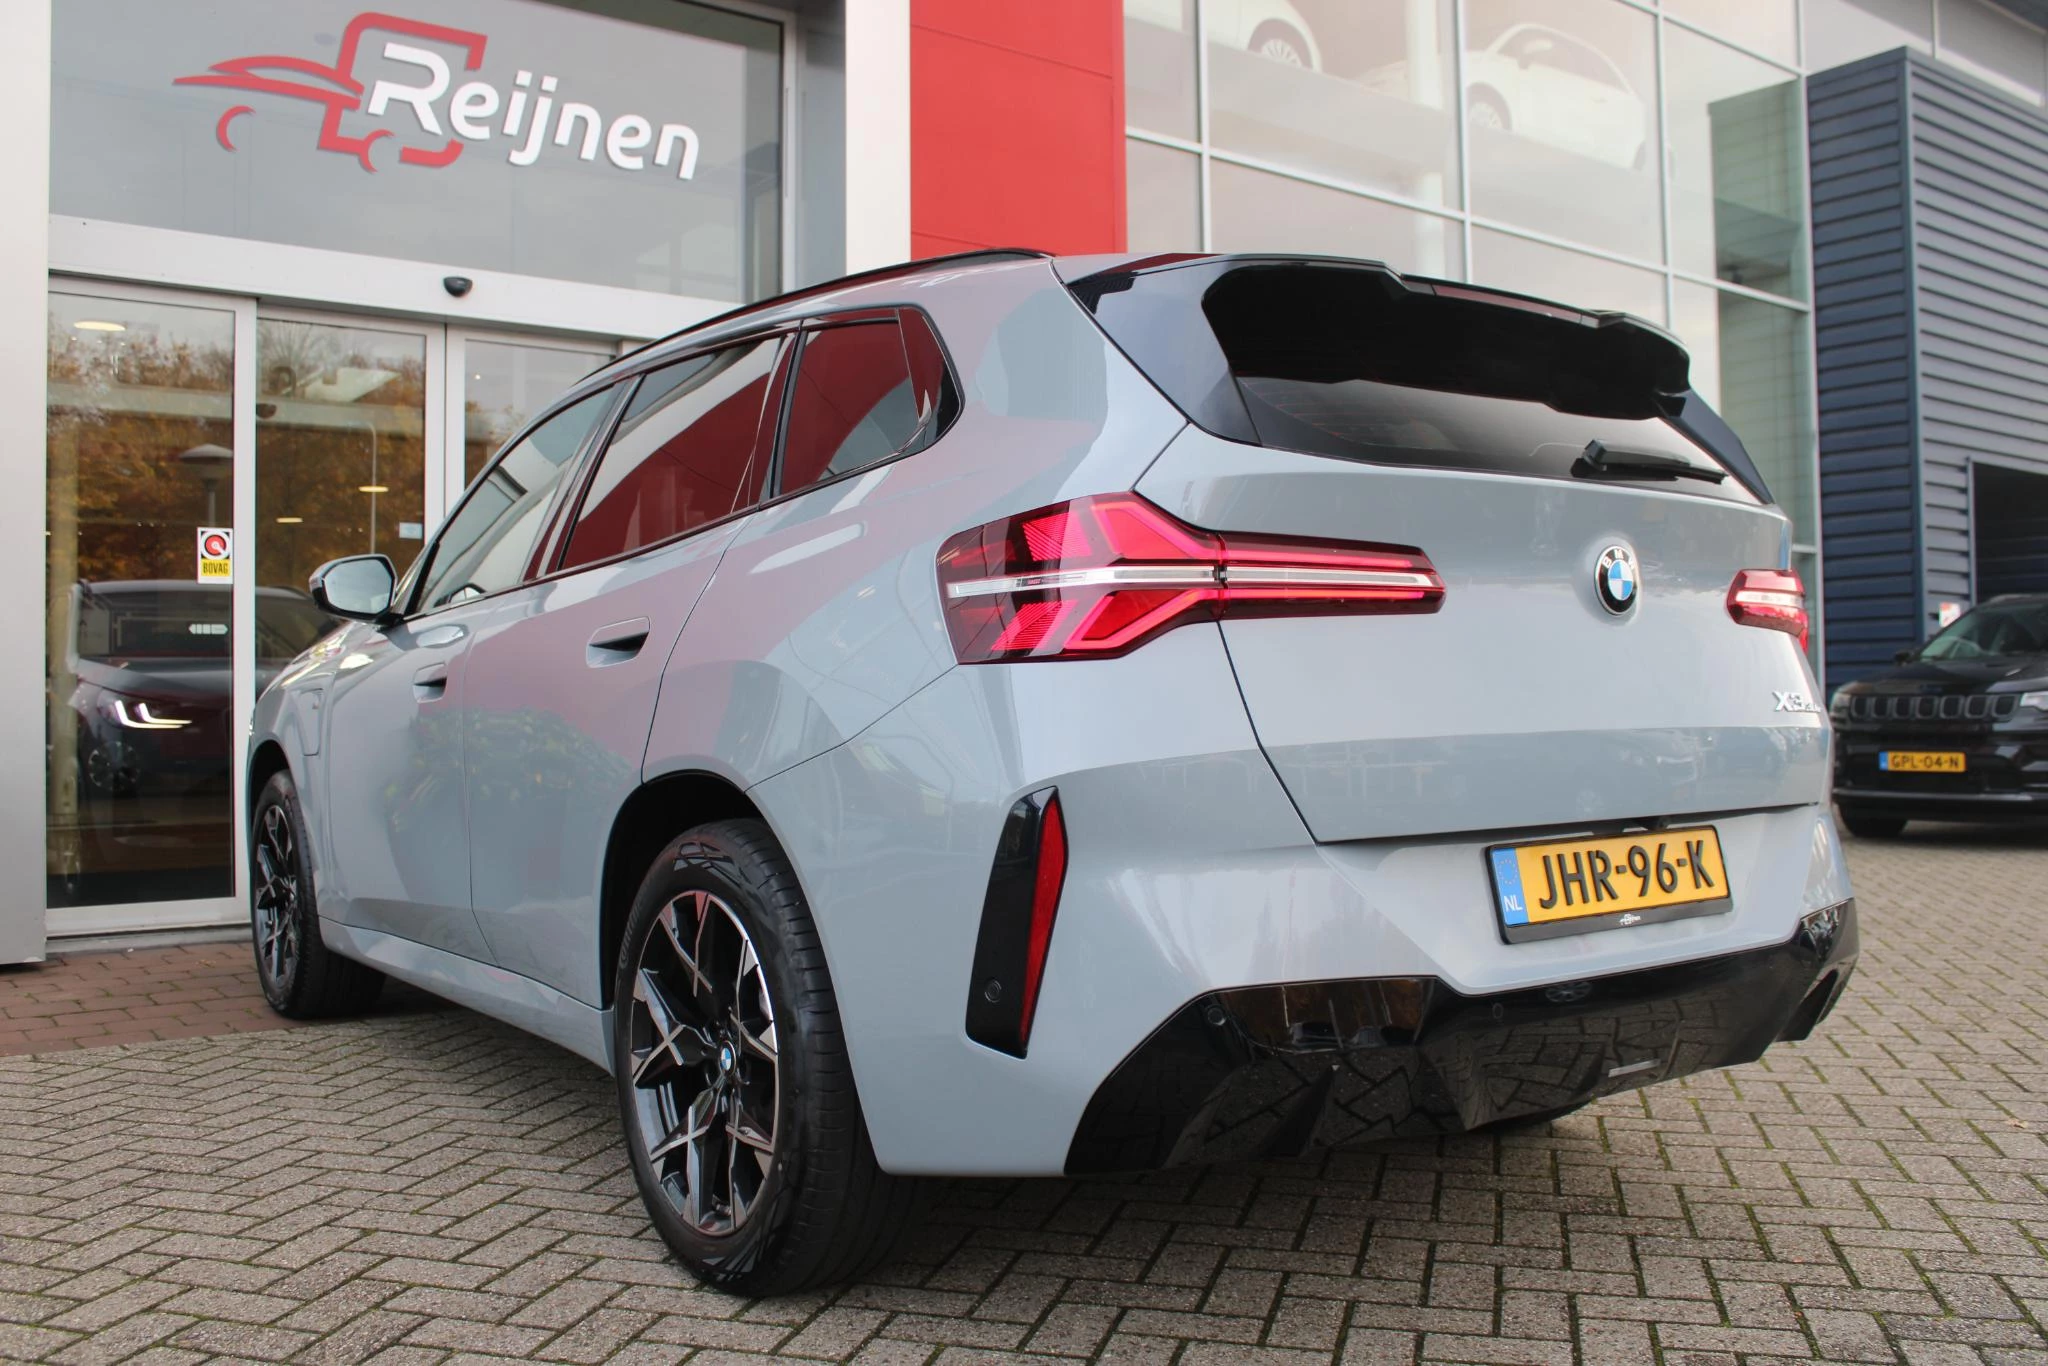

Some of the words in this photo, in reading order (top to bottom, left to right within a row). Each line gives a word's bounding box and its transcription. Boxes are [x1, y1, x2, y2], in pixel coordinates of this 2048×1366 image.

[367, 42, 699, 180] Reijnen
[202, 562, 229, 574] BOVAG
[1891, 755, 1959, 768] GPL-04-N
[1539, 840, 1715, 909] JHR-96-K
[1504, 894, 1523, 911] NL
